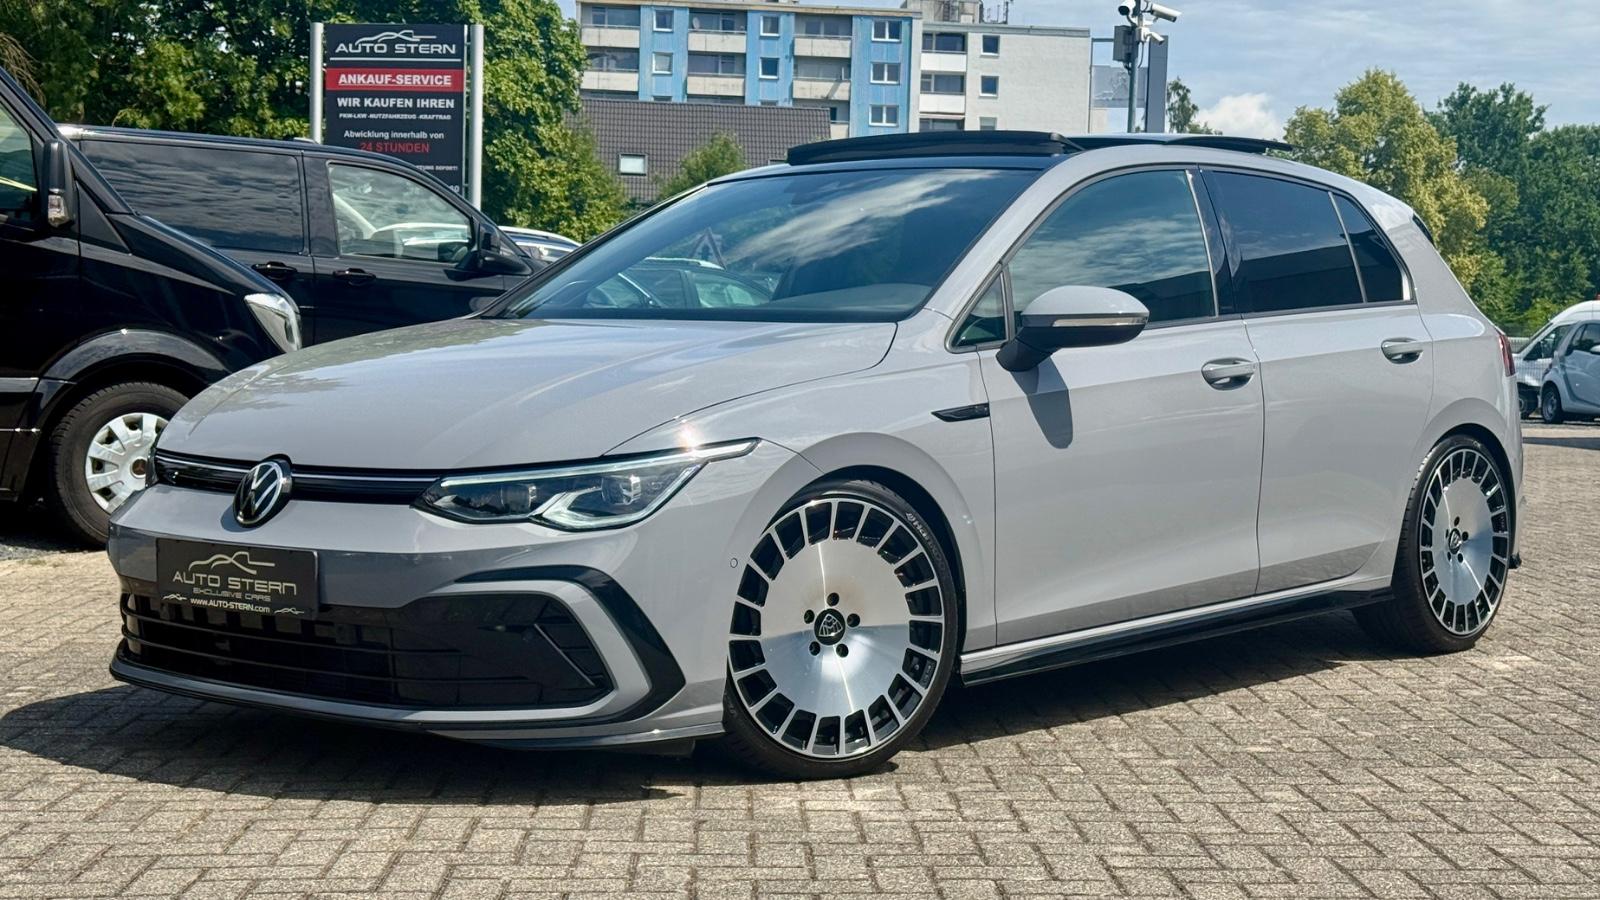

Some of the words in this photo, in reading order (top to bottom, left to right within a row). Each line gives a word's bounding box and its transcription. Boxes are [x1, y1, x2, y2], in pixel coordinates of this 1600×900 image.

[335, 43, 387, 53] AUTO
[395, 44, 456, 54] STERN
[338, 74, 452, 86] ANKAUF-SERVICE
[337, 97, 361, 108] WIR
[364, 98, 413, 108] KAUFEN
[416, 98, 455, 109] IHREN
[343, 130, 390, 140] Abwicklung
[391, 131, 428, 139] innerhalb
[360, 142, 373, 151] 24
[376, 142, 430, 153] STUNDEN
[172, 571, 221, 587] AUTO
[227, 577, 297, 596] STERN
[192, 587, 242, 599] EXCLUSIVE
[244, 593, 272, 602] CARS
[190, 598, 271, 613] www.AUTO-STERN.com
